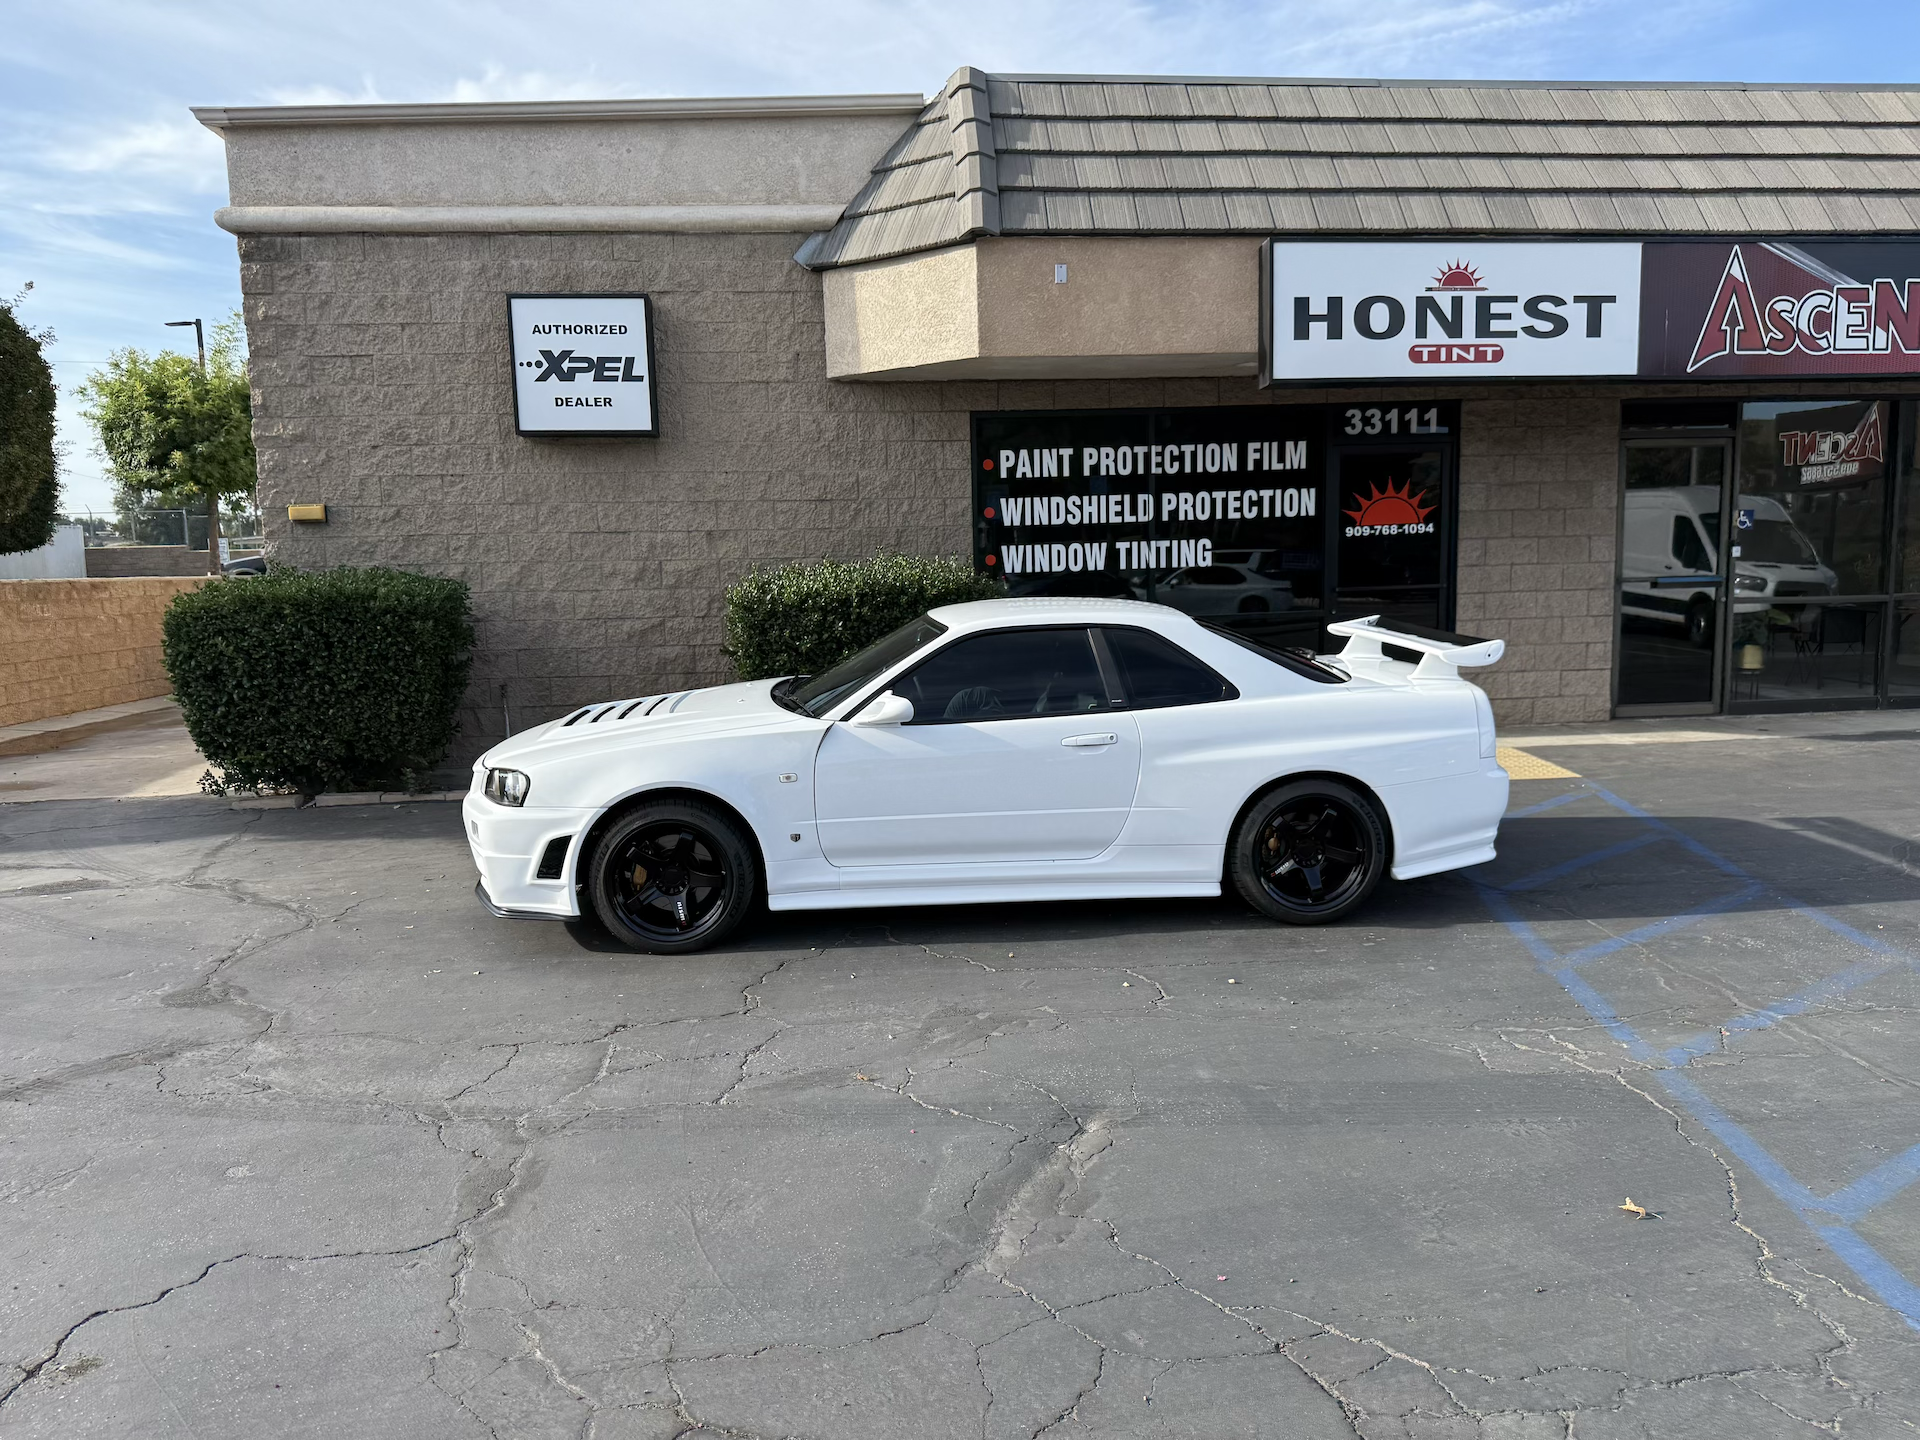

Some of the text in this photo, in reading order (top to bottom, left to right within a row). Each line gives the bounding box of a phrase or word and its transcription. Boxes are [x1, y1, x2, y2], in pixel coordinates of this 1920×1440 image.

[532, 324, 628, 335] AUTHORIZED
[1293, 294, 1617, 341] HONEST
[534, 350, 644, 382] XPEL
[1412, 346, 1501, 362] TINT
[554, 397, 613, 407] DEALER
[1344, 408, 1438, 435] 33111
[1000, 440, 1307, 479] PAINT PROTECTION FILM
[1000, 487, 1316, 527] WINDSHIELD PROTECTION
[1345, 523, 1434, 537] 909-768-1094
[1001, 538, 1213, 574] WINDOW TINTING
